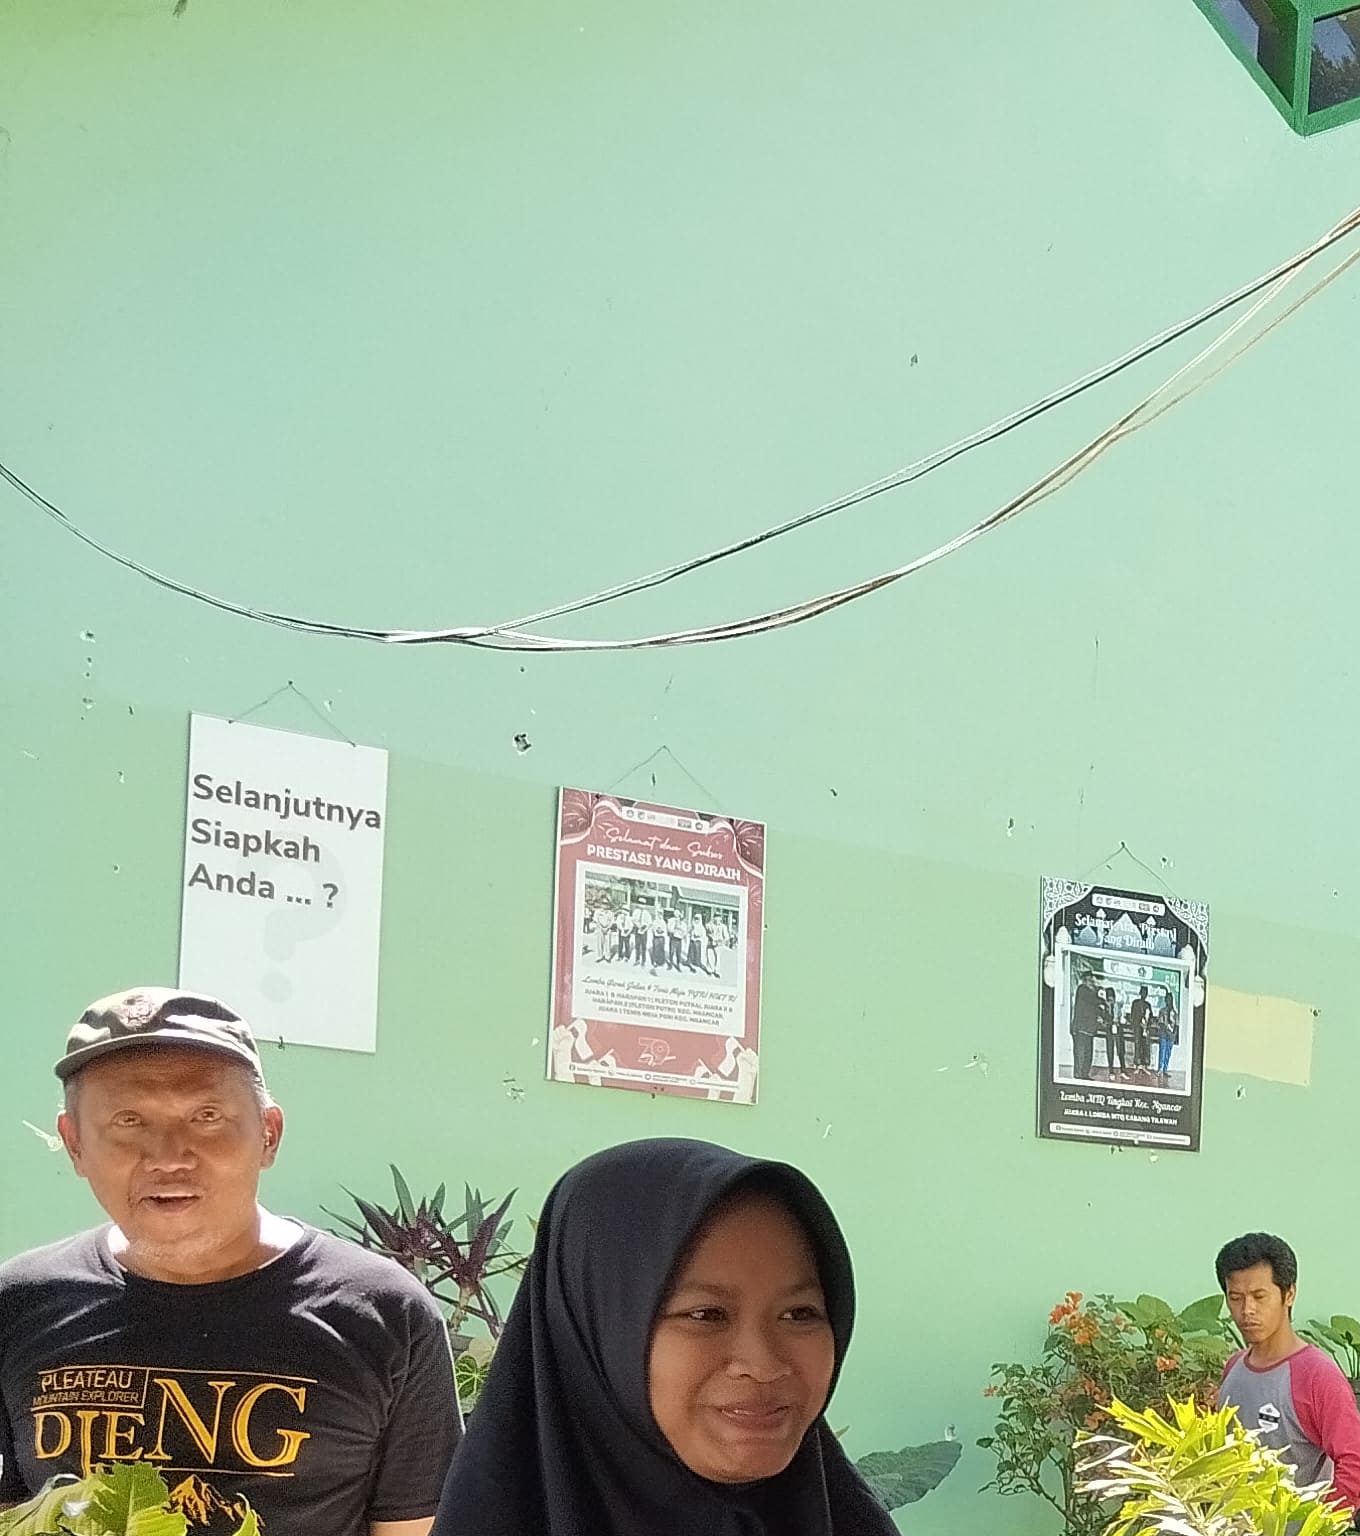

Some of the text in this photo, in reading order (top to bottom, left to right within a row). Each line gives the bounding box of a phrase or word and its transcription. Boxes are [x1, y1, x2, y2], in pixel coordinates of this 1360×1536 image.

[193, 774, 381, 830] Selanjutnya
[191, 818, 321, 863] Siapkah
[587, 844, 741, 881] PRESTASI YANG DIRAIH
[188, 863, 275, 899] Anda
[322, 883, 339, 908] ?
[32, 1389, 140, 1406] MOUNTAIN EXPLORER
[41, 1369, 133, 1392] PLEATEAU
[33, 1377, 311, 1477] DIENG
